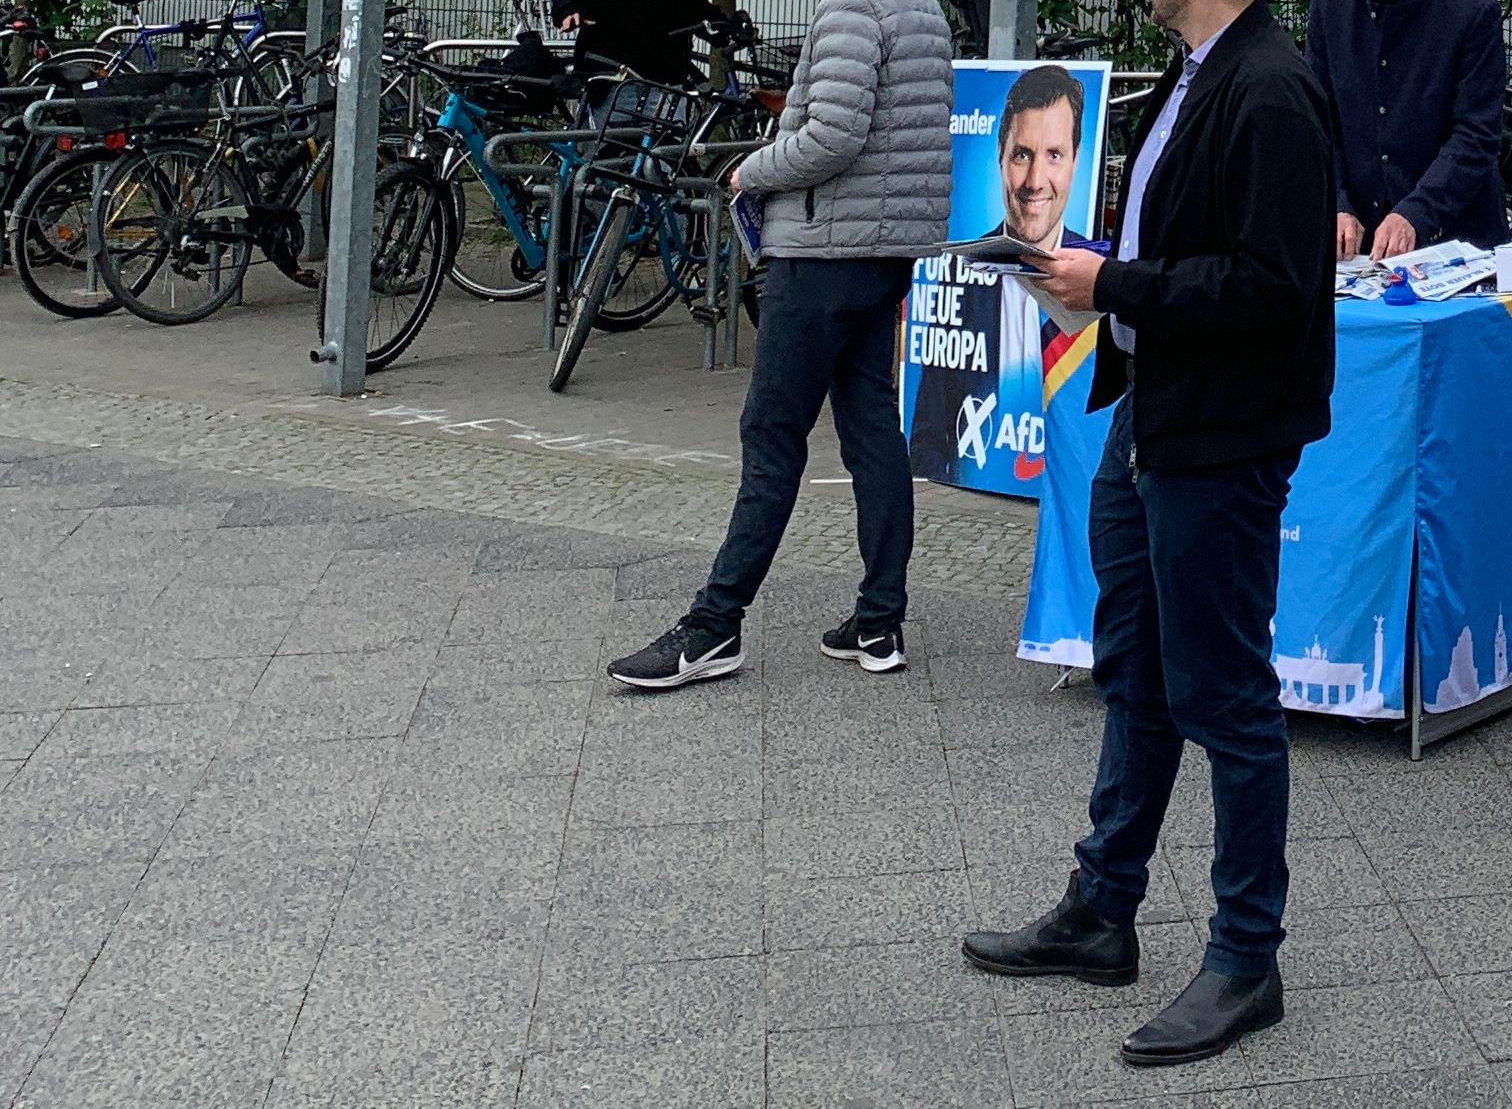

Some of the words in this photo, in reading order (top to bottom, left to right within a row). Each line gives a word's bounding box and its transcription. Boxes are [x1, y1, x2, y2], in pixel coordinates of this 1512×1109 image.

[950, 108, 997, 136] ander
[911, 283, 964, 326] NEUE
[910, 325, 988, 373] EUROPA
[994, 412, 1046, 454] AfD
[1280, 525, 1300, 542] nd
